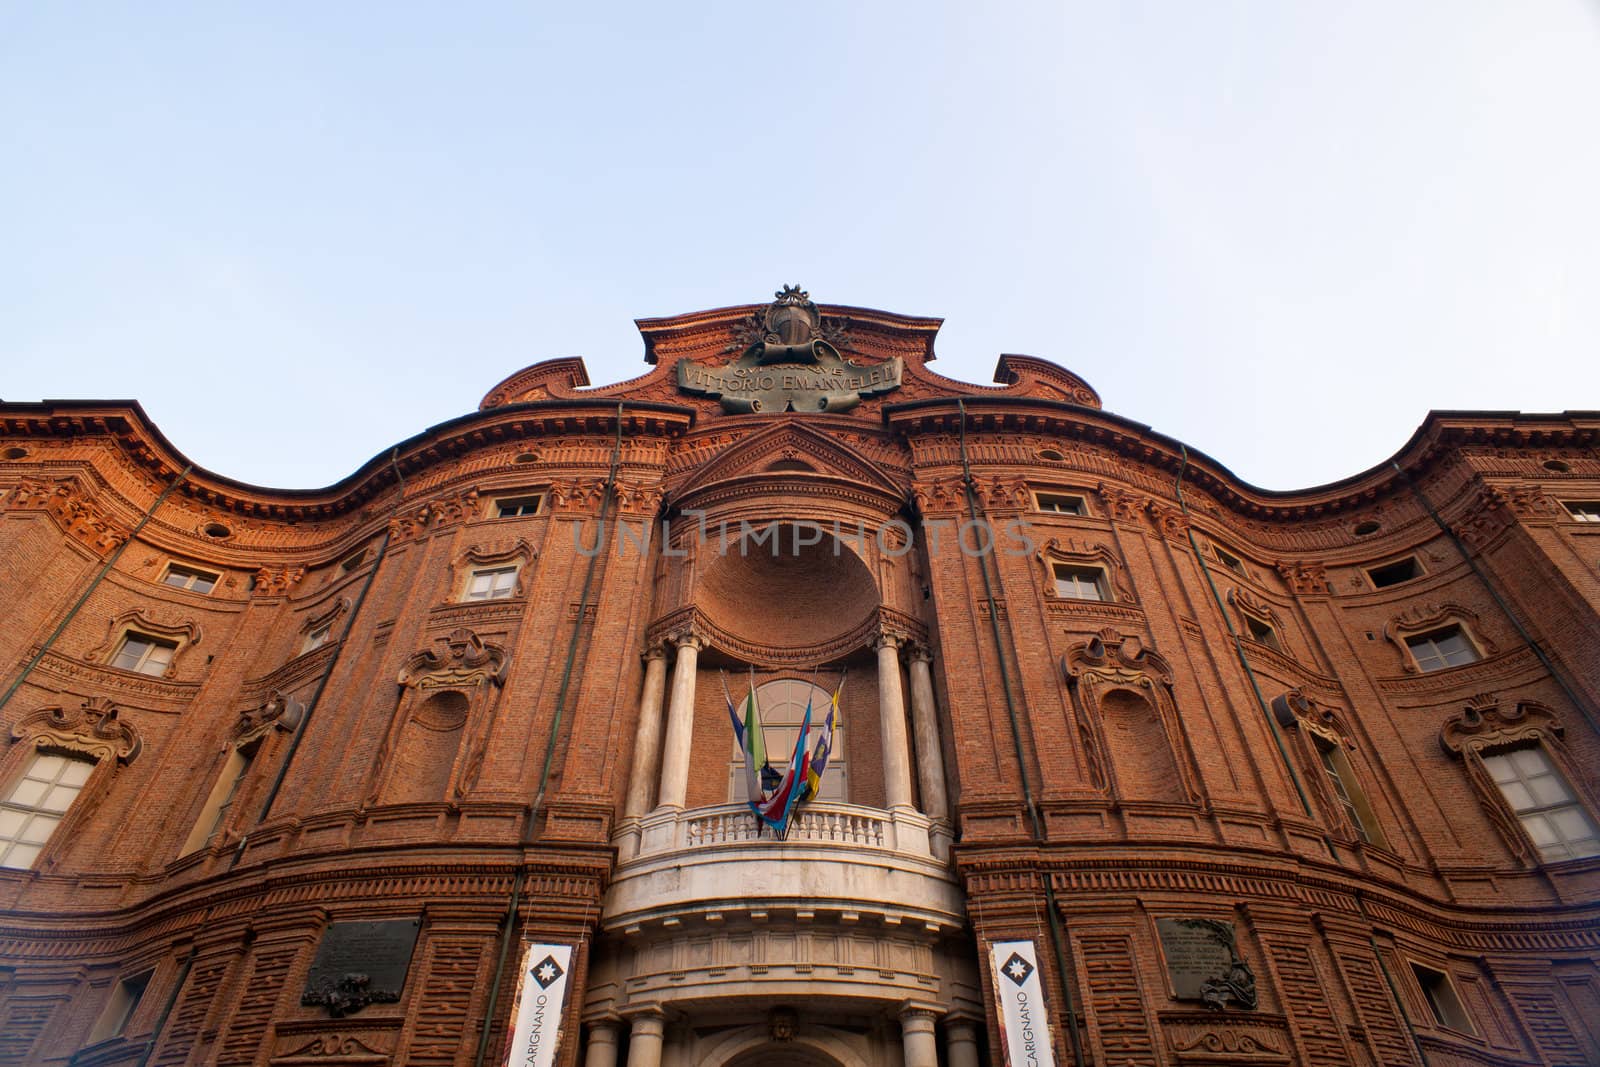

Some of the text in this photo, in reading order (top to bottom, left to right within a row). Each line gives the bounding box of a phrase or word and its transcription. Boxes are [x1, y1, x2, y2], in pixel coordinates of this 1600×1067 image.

[684, 365, 896, 392] VITTORIO EMANVELE II
